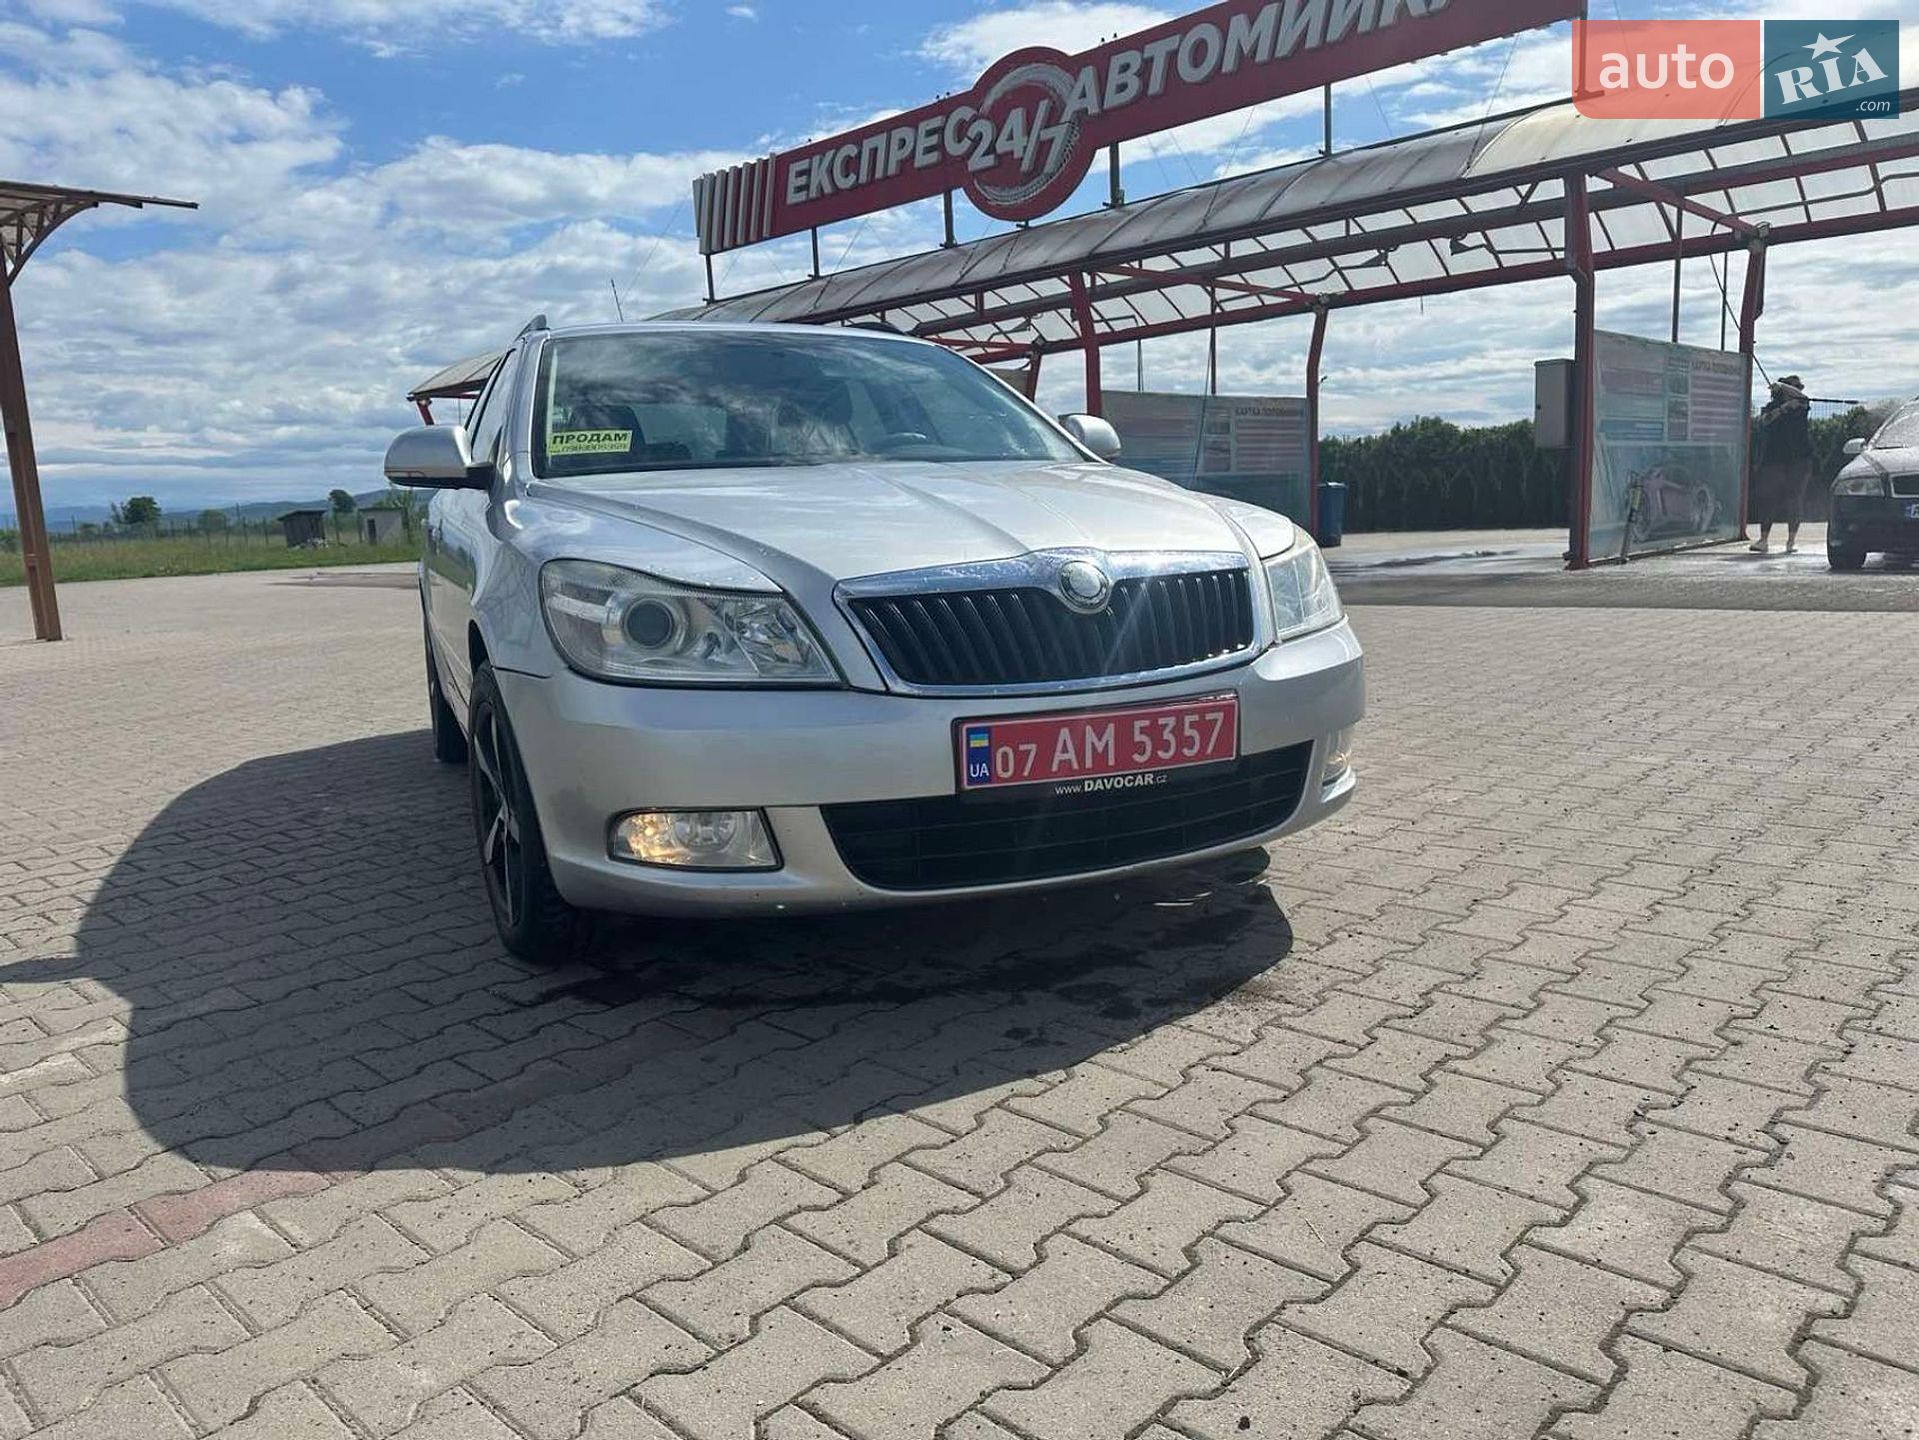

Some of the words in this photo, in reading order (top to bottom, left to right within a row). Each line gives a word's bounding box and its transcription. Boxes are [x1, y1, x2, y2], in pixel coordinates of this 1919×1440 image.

[786, 105, 978, 205] ЕКСПРЕС
[967, 99, 1072, 174] 24/7
[1058, 0, 1450, 121] АВТОМИЙ
[552, 433, 628, 445] ПРОДАМ
[995, 743, 1038, 779] 07
[1051, 723, 1116, 772] AM
[1131, 711, 1225, 764] 5357
[969, 762, 990, 778] UA
